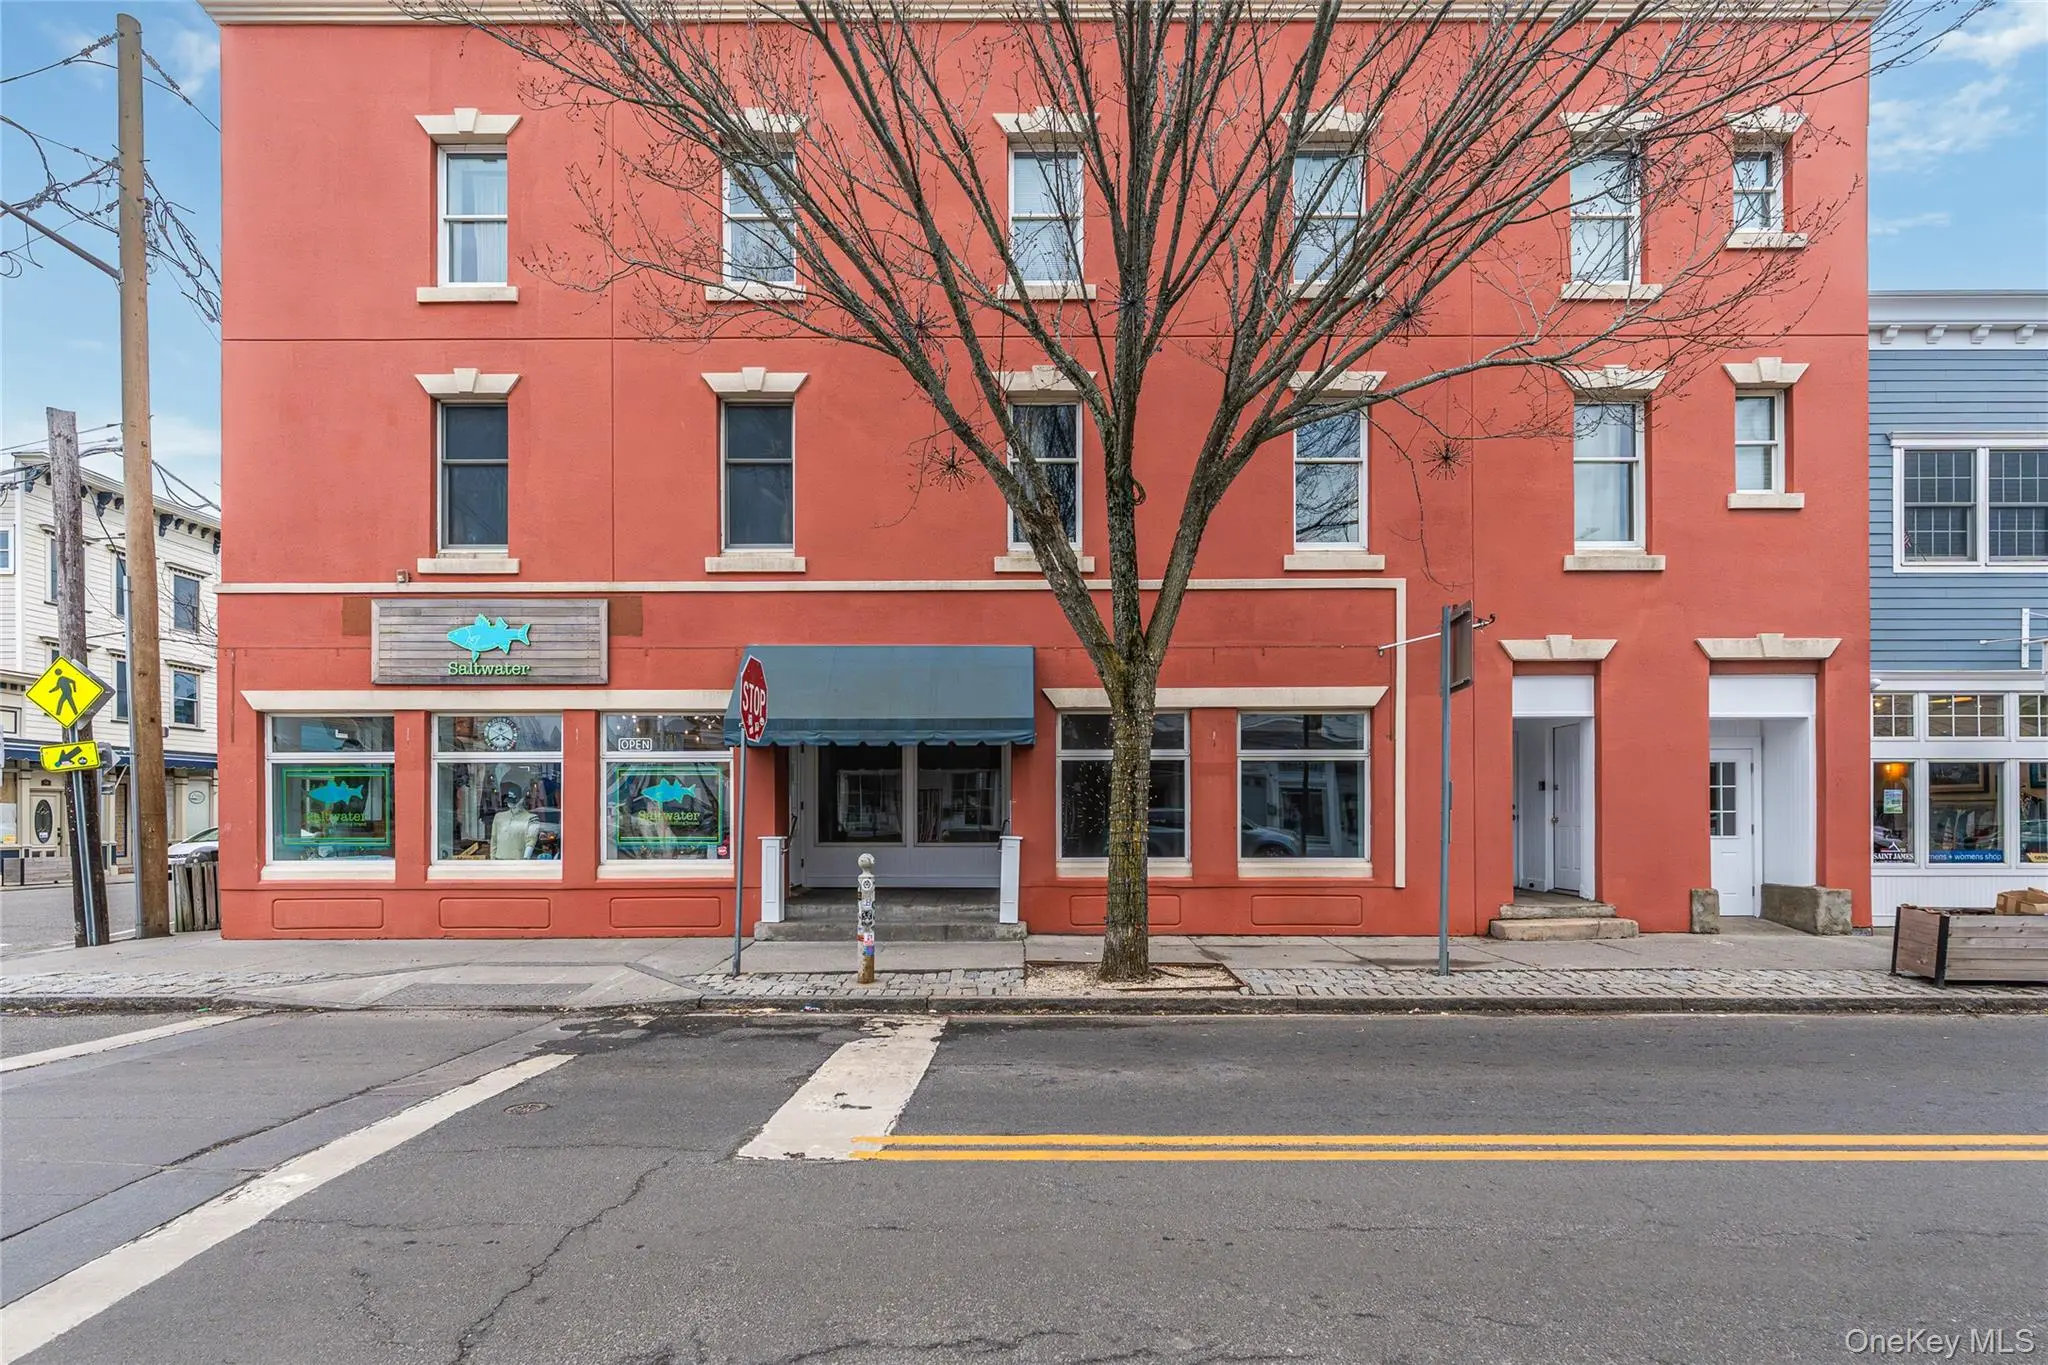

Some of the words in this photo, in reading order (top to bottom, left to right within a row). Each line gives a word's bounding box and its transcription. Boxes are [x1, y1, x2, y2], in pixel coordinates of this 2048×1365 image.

[448, 662, 530, 676] Saltwater
[742, 681, 766, 717] STOP
[620, 740, 650, 749] OPEN
[1985, 853, 2002, 861] shop
